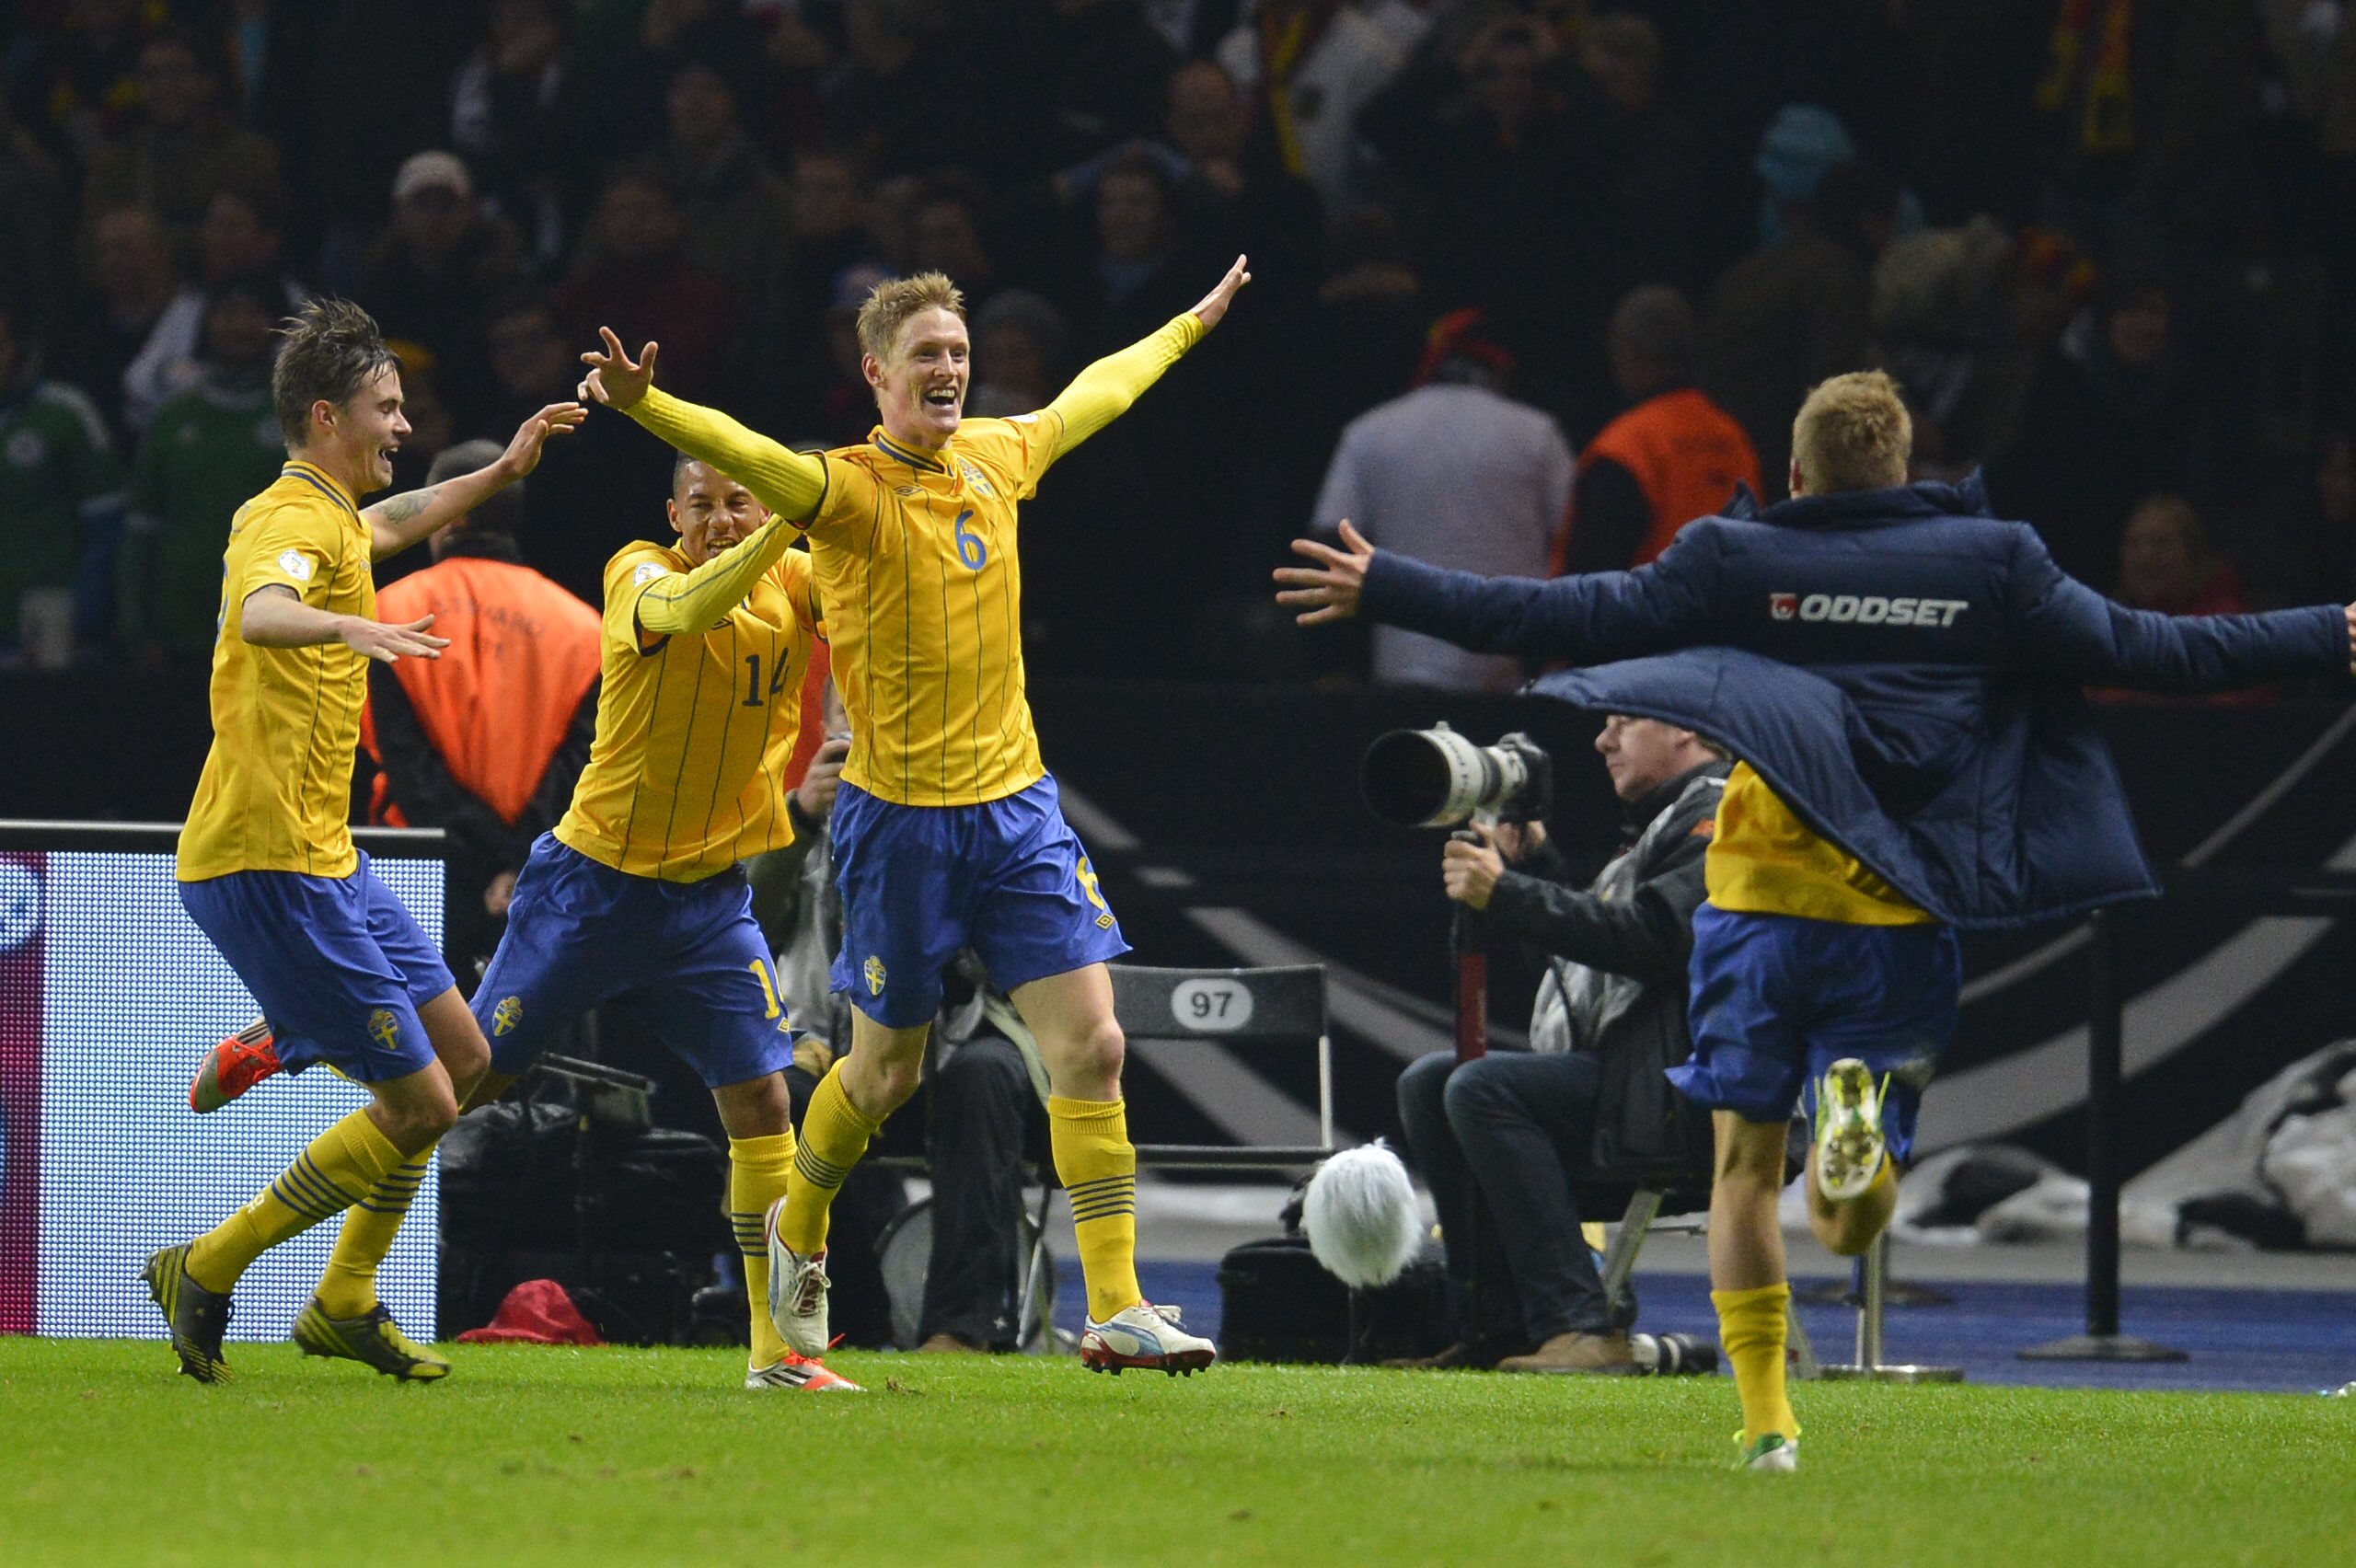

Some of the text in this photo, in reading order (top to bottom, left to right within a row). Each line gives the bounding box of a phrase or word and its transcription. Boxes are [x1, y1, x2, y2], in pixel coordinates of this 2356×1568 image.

[954, 509, 987, 571] 6
[1799, 594, 1969, 628] ODDSET
[742, 647, 791, 707] 14
[1191, 991, 1232, 1018] 97
